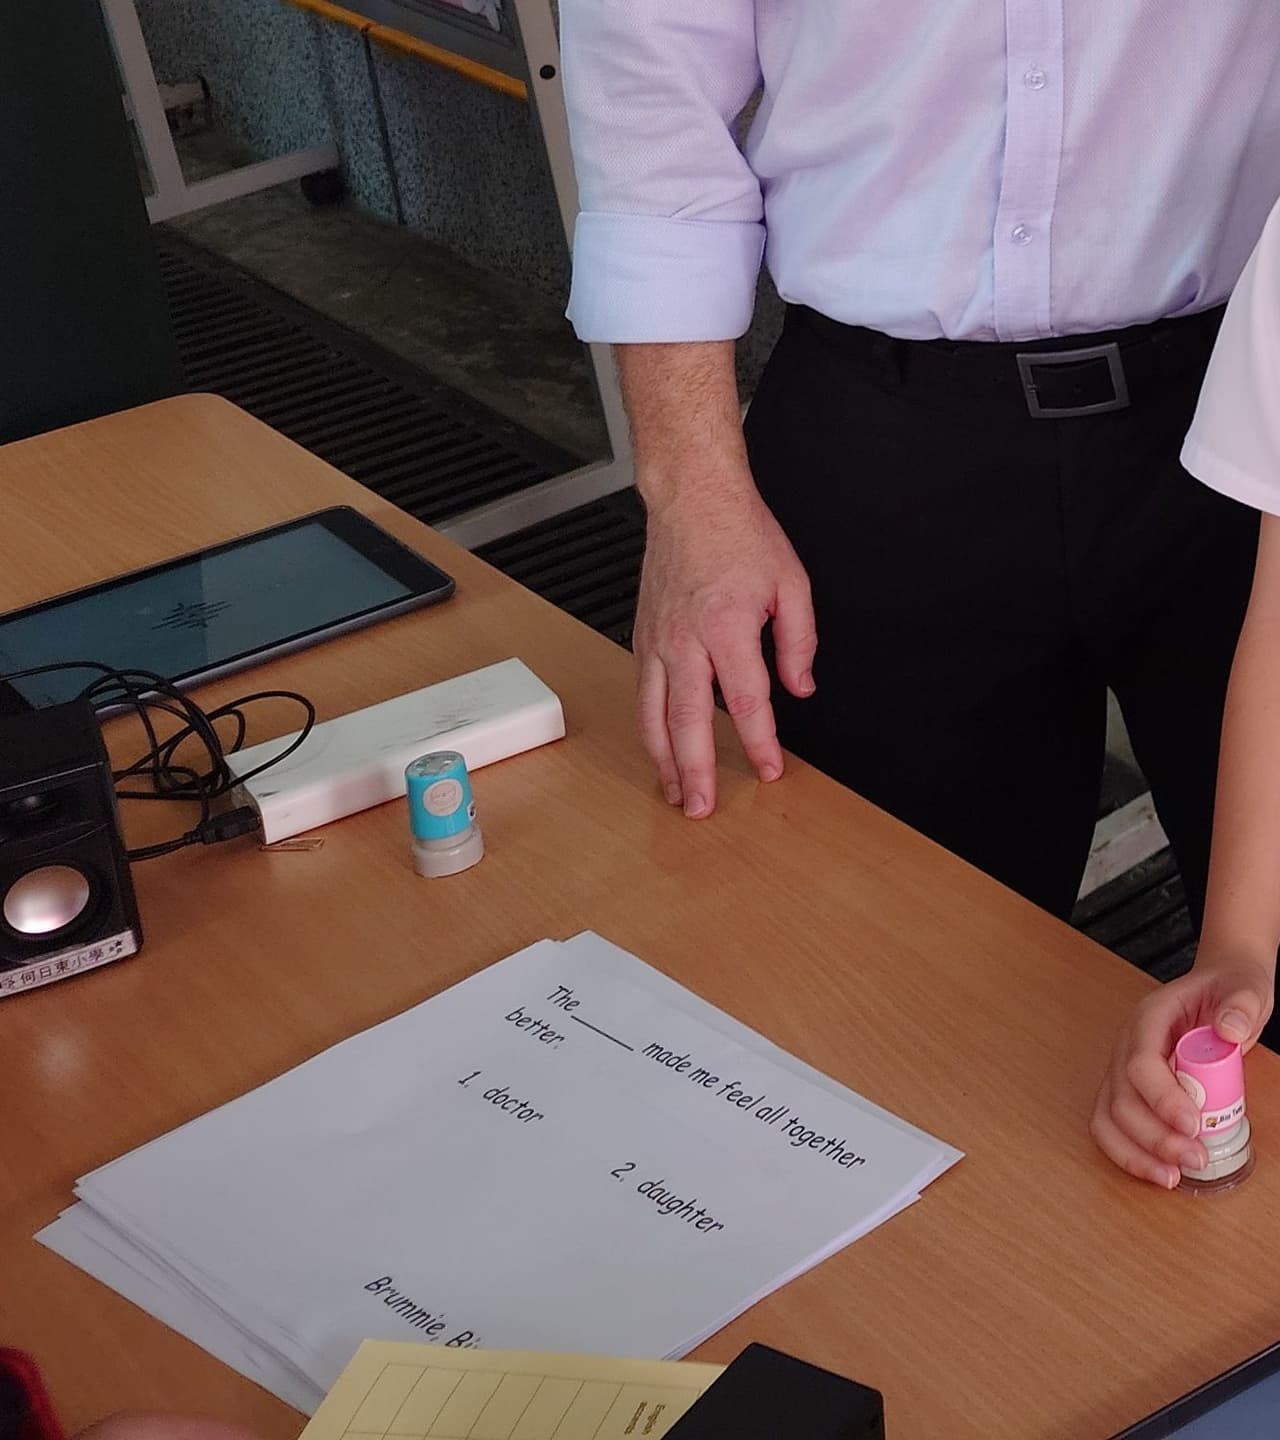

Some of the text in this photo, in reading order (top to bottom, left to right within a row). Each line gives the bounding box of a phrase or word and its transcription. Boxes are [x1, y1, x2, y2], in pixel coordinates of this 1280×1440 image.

[505, 1007, 568, 1050] better.
[458, 1070, 545, 1123] 1. doctor
[547, 985, 866, 1170] The made me feel all together
[611, 1162, 725, 1234] 2. daughter
[364, 1275, 446, 1342] Brummie,
